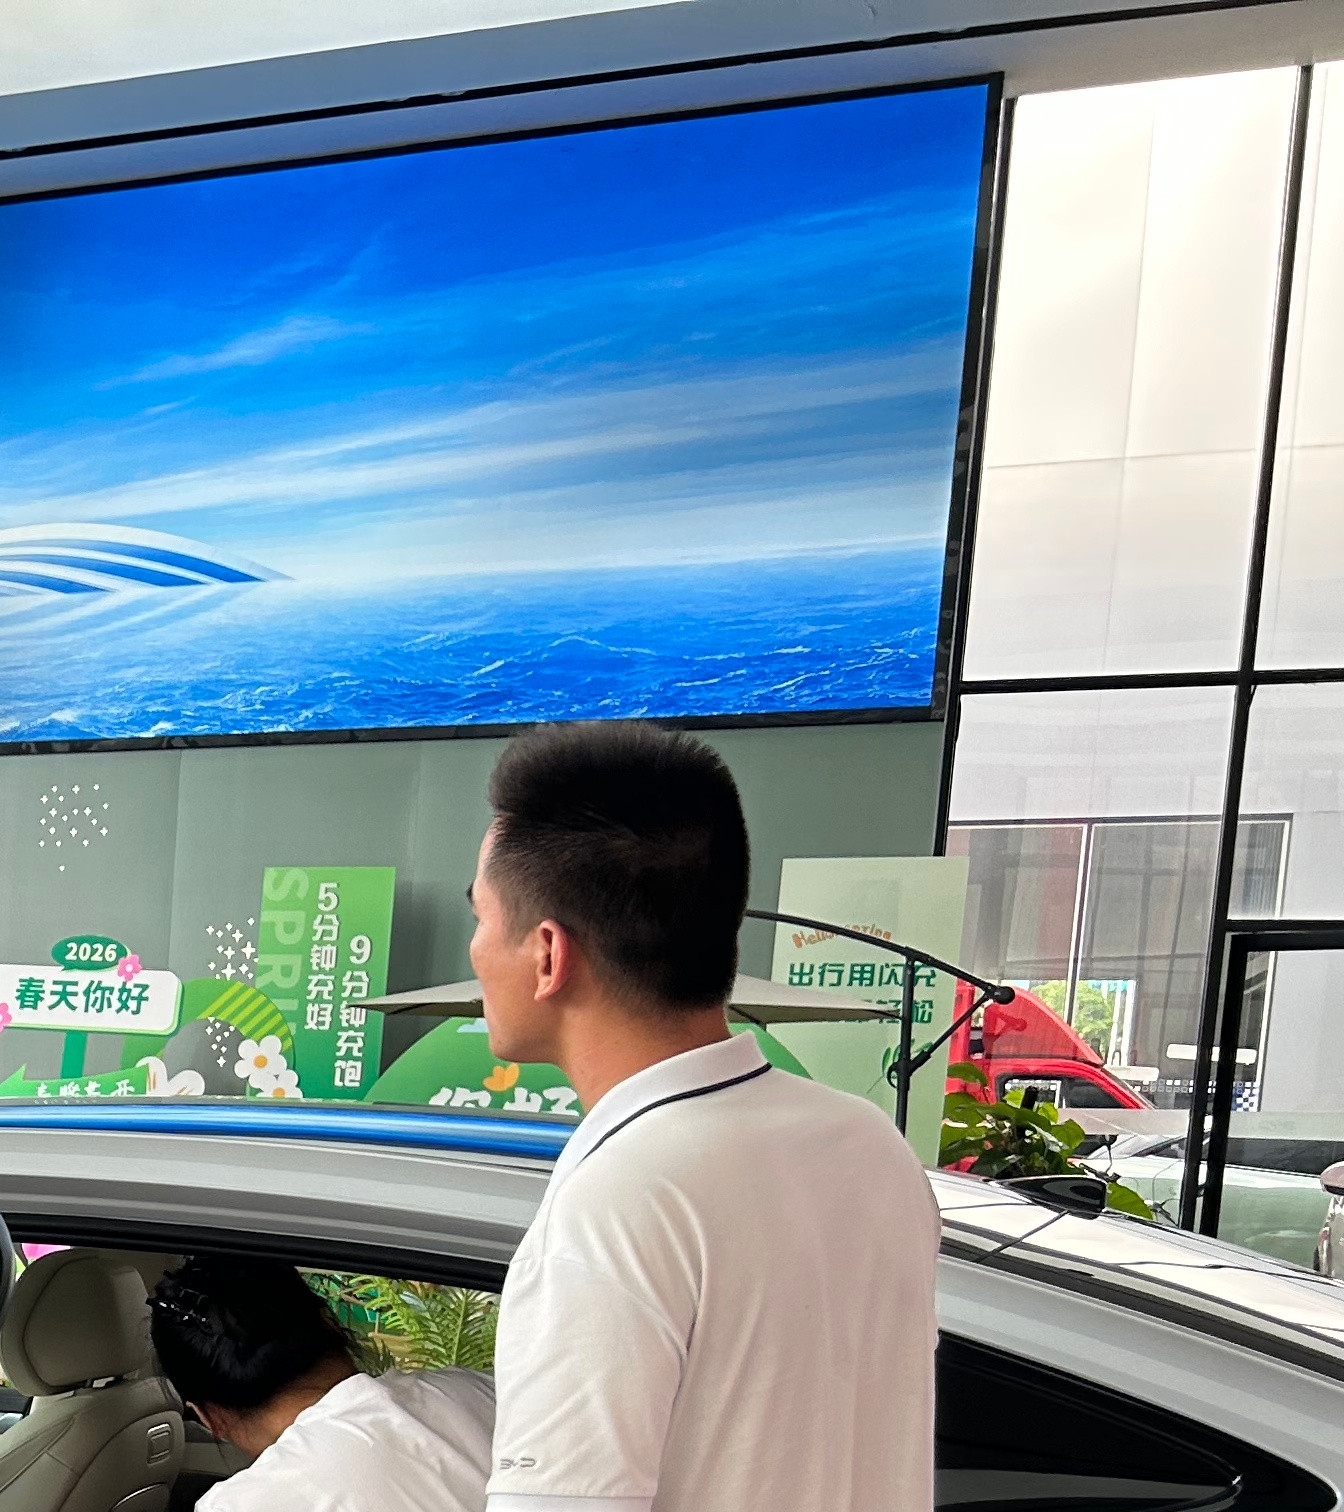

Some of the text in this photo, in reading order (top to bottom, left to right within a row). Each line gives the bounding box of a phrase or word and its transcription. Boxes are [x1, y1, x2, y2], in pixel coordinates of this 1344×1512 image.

[15, 977, 151, 1016] 春天你好
[64, 942, 118, 963] 2026
[256, 867, 310, 1037] SPRI
[304, 882, 341, 1032] 5分钟充好
[334, 934, 373, 1088] 9分钟充饱
